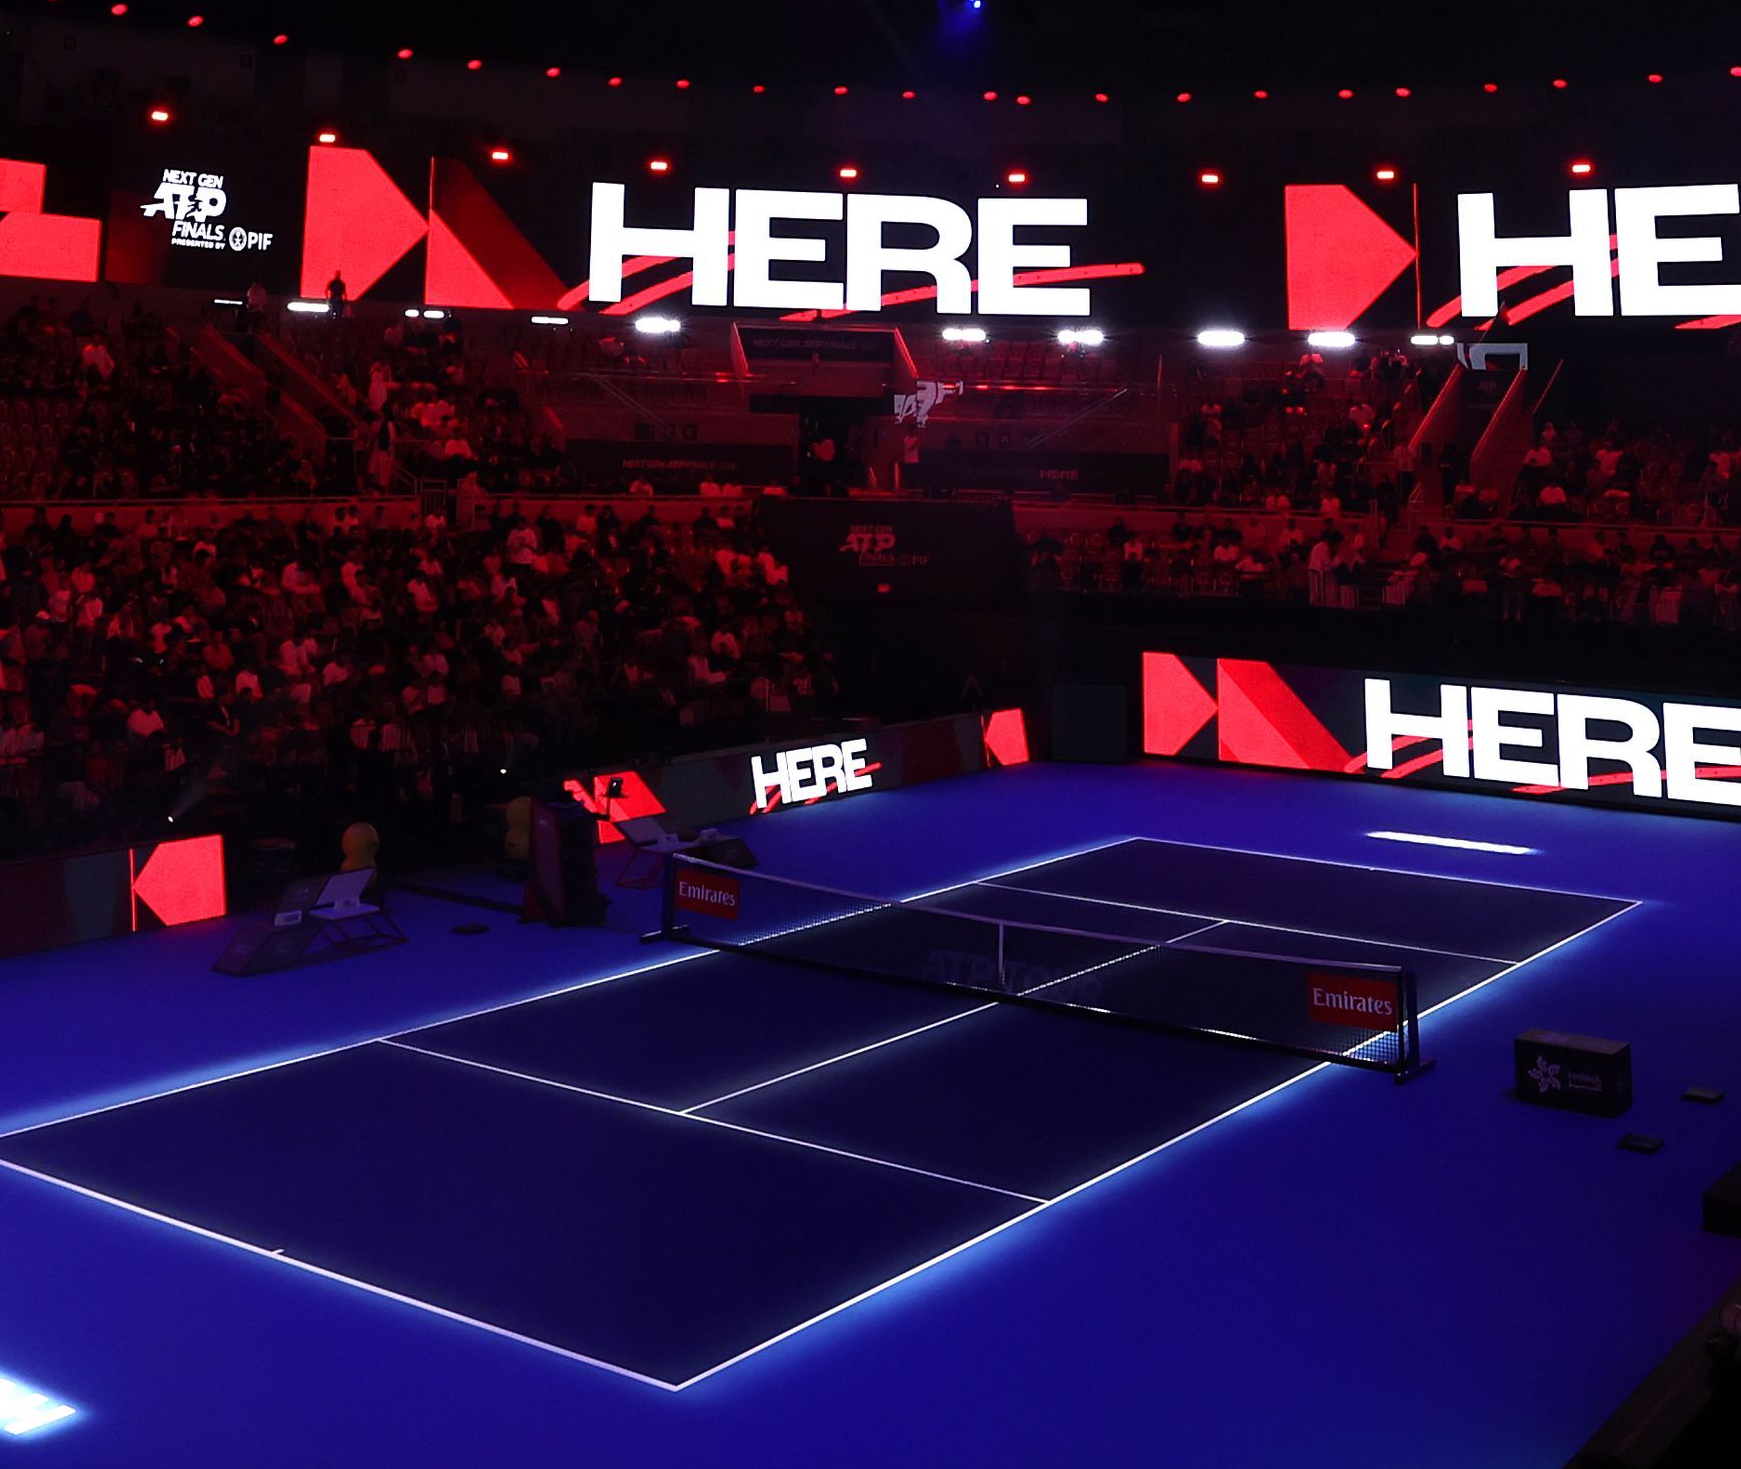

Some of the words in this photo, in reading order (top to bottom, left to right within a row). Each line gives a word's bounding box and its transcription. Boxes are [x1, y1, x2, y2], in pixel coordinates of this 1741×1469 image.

[162, 168, 197, 186] NEXT
[197, 173, 224, 189] GEN
[140, 182, 227, 223] ATP
[247, 231, 274, 251] PIF
[589, 181, 1091, 317] HERE
[751, 738, 874, 809] HERE
[1312, 986, 1393, 1016] Emirates
